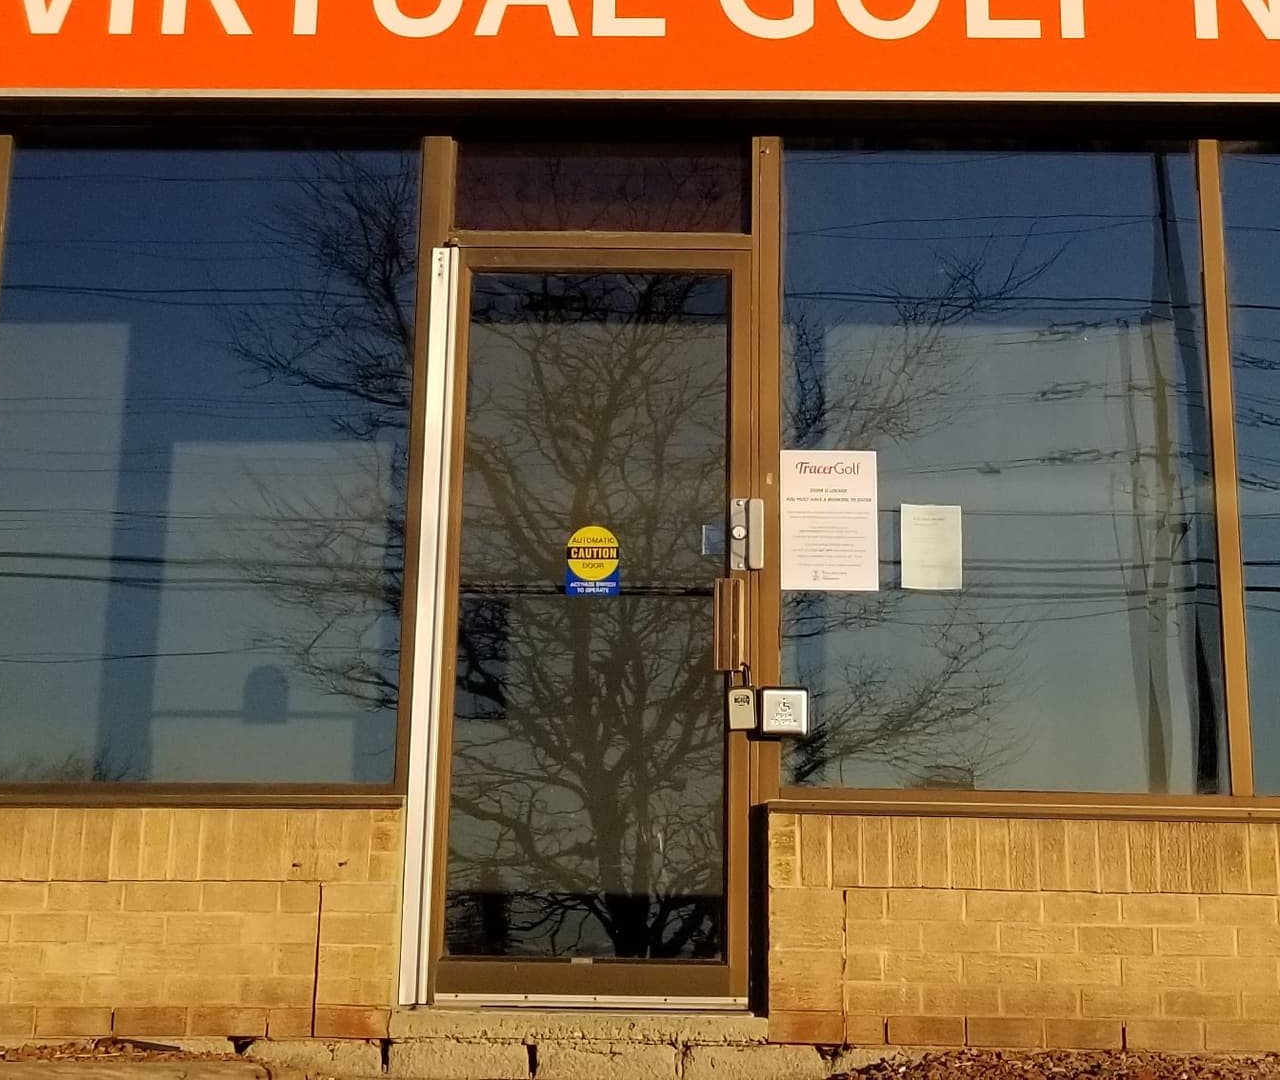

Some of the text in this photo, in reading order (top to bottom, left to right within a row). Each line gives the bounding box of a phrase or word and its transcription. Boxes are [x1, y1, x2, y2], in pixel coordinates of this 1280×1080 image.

[795, 461, 861, 476] TracerGolf
[572, 536, 615, 544] AUTOMATIC
[570, 547, 617, 559] CAUTION
